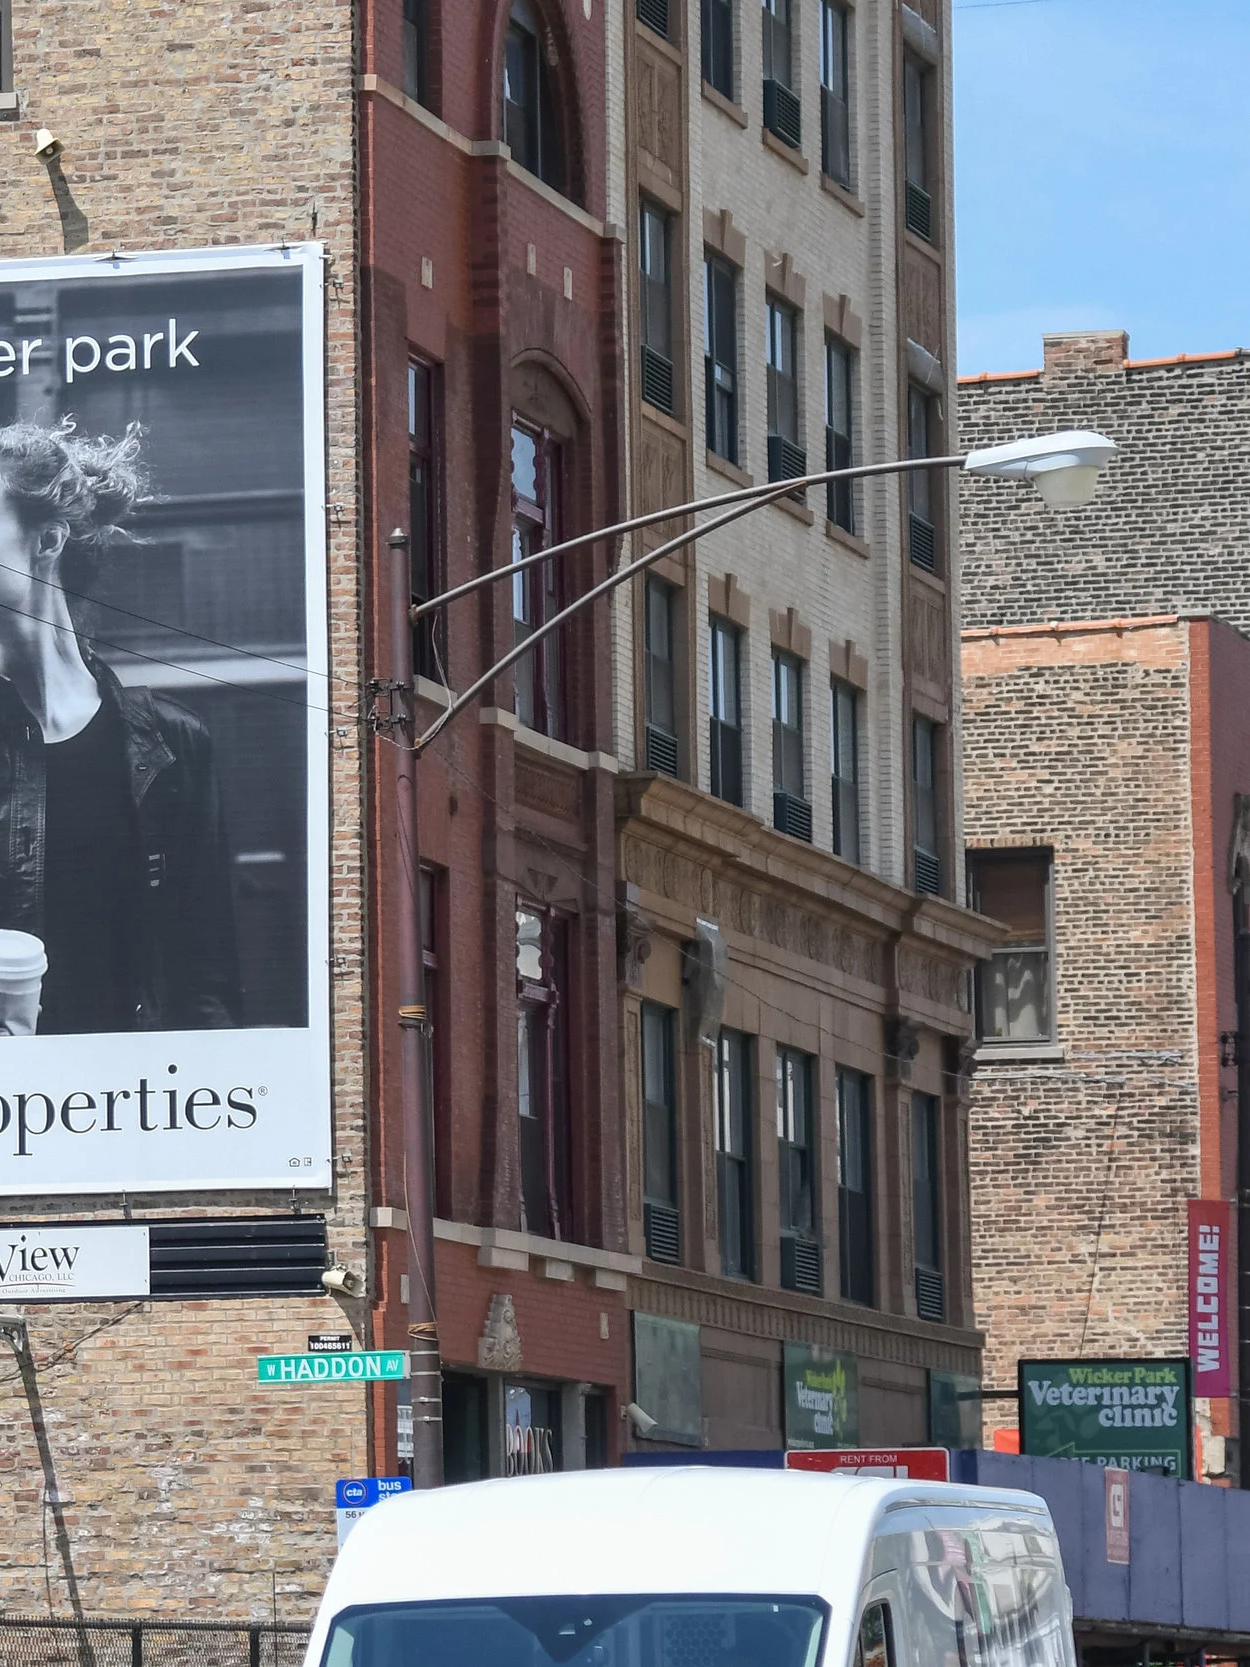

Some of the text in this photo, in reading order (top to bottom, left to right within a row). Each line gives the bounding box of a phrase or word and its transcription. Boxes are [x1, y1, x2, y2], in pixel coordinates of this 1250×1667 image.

[66, 318, 200, 383] park
[9, 1273, 74, 1282] CHICAGO, LLC
[1197, 1225, 1221, 1372] WELCOME!
[267, 1356, 399, 1380] W HADDON AV
[1069, 1367, 1177, 1384] Wicker Park
[1028, 1380, 1180, 1408] Veterinary
[1099, 1406, 1178, 1427] clinic
[840, 1455, 898, 1464] RENT FROM
[346, 1480, 402, 1497] cta bus
[378, 1491, 398, 1501] st
[345, 1511, 357, 1519] 56
